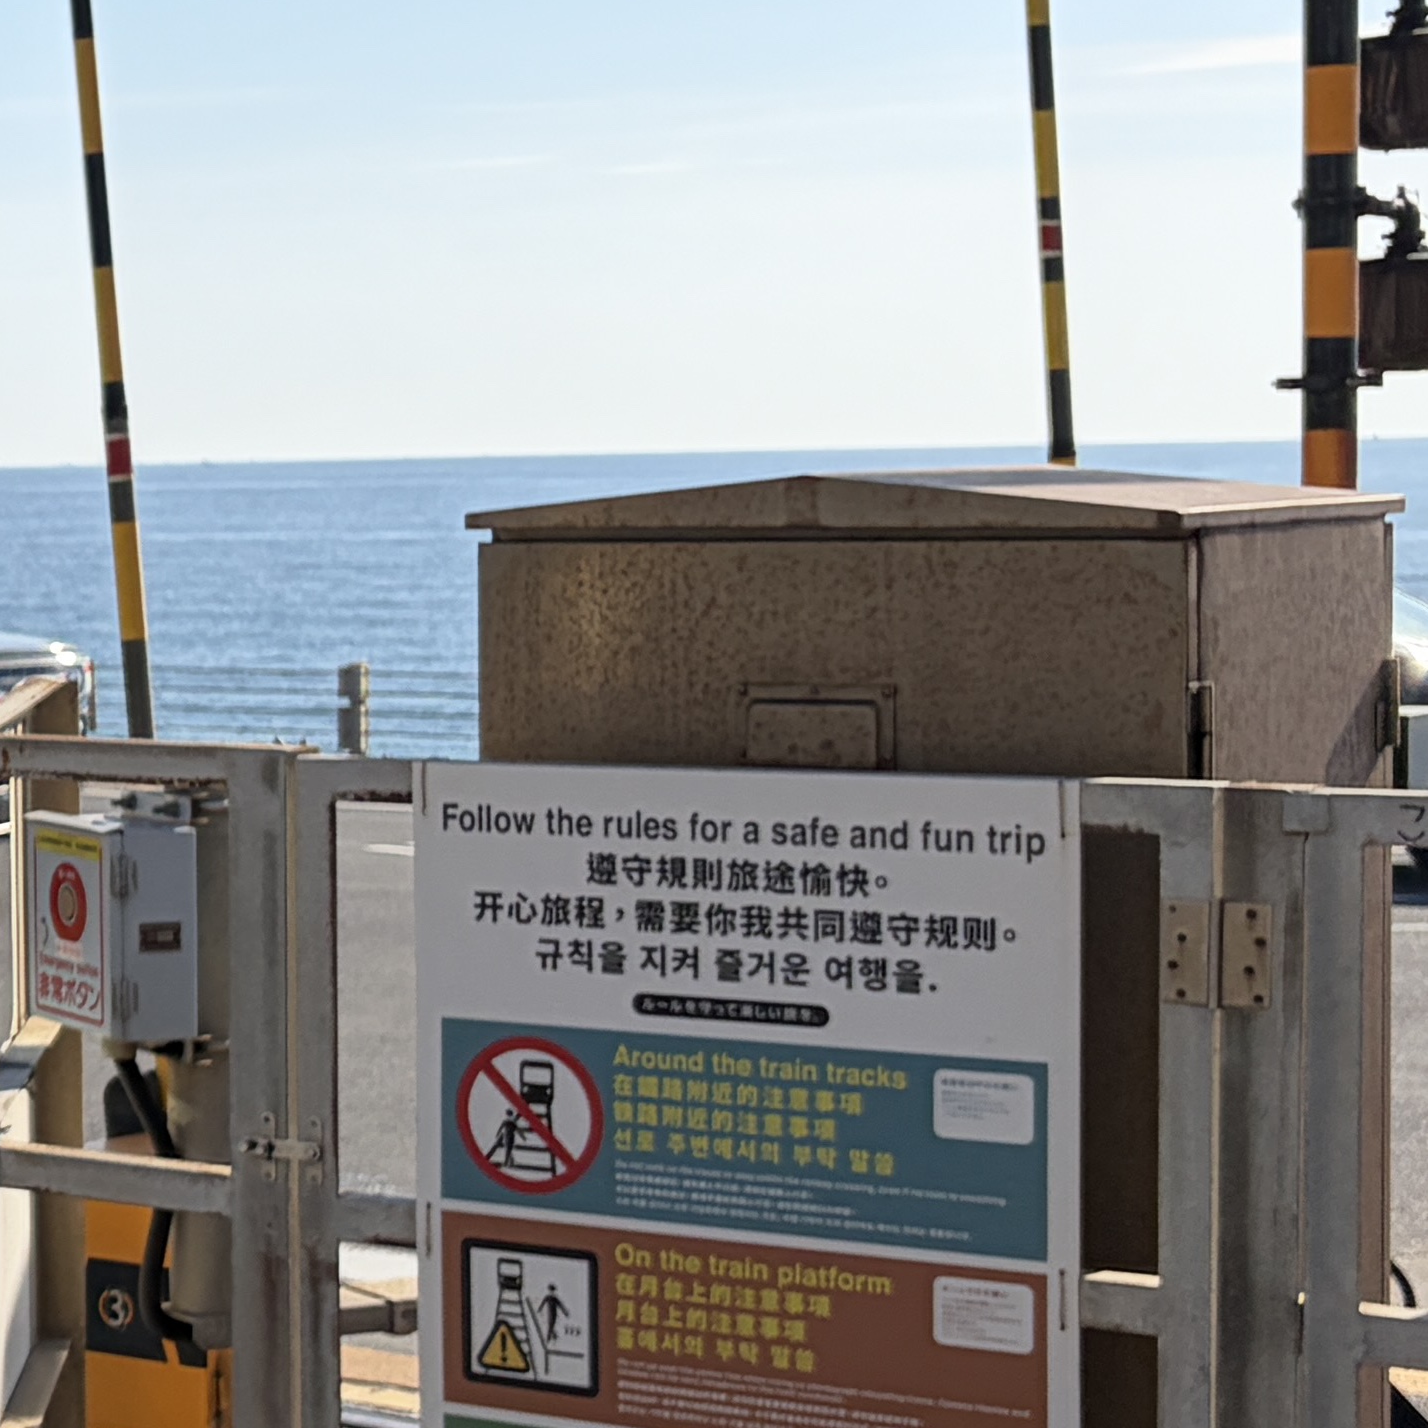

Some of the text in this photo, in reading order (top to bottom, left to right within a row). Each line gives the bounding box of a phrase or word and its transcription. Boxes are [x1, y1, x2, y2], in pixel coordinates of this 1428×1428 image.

[442, 803, 1045, 863] Follow the rules for a safe and fun trip
[586, 853, 888, 897] 遵守規則旅途愉快。
[473, 893, 1016, 951] 开心旅程，需要你我共同遵守规则。
[535, 939, 937, 993] 규칙을 지켜 즐거운 여행을.
[613, 1044, 909, 1090] Around the train tracks
[615, 1243, 893, 1295] On the train platform
[108, 1289, 126, 1326] 3
